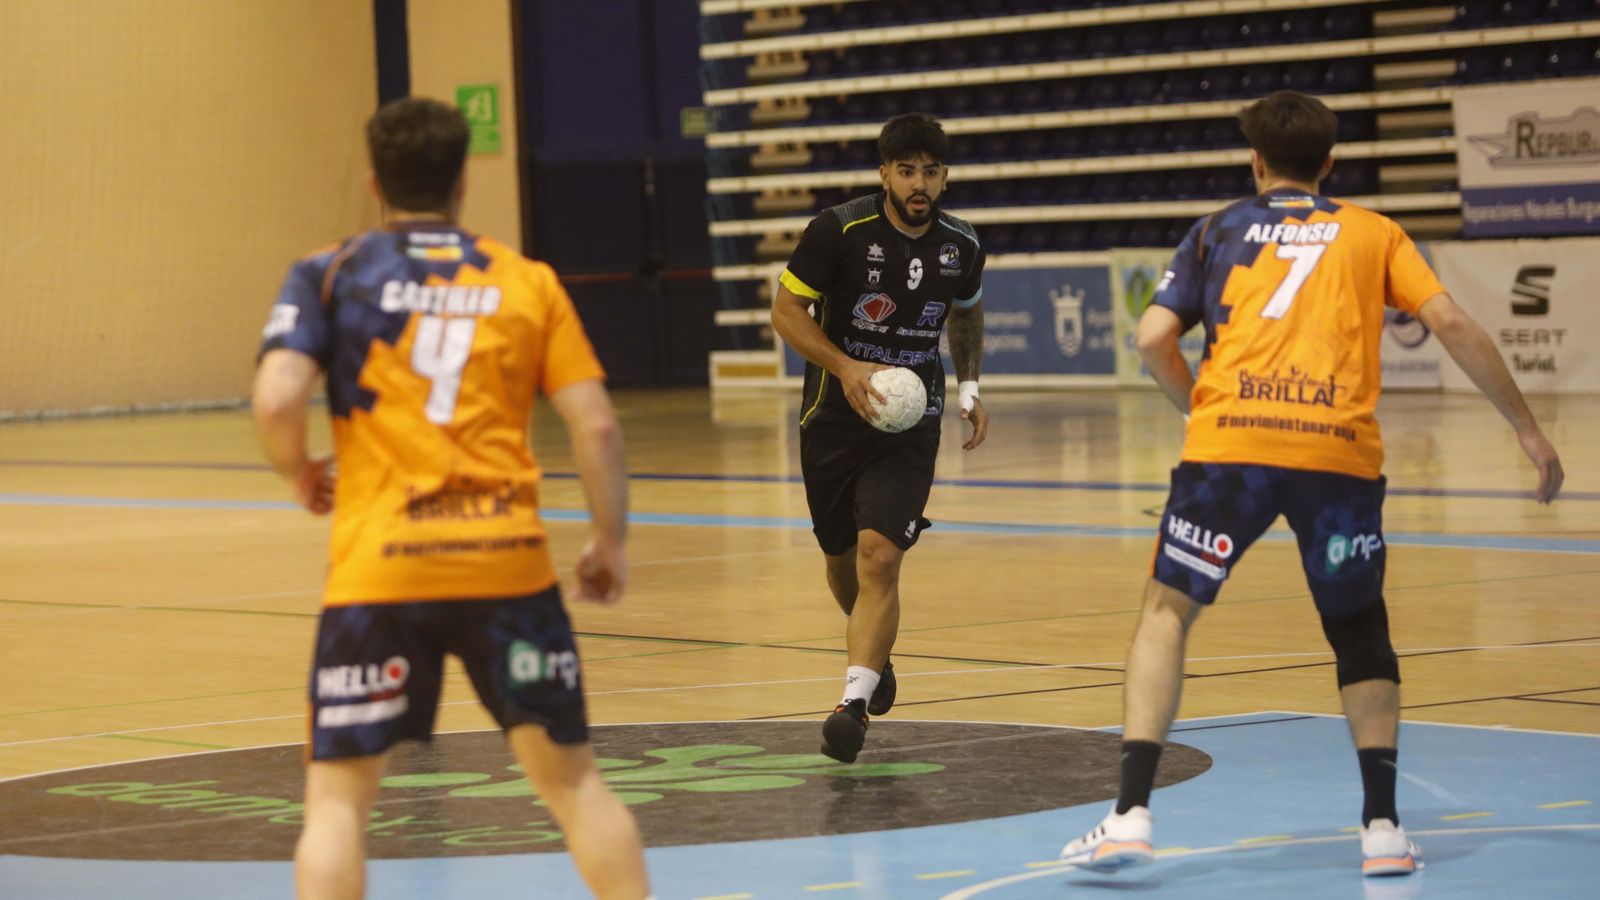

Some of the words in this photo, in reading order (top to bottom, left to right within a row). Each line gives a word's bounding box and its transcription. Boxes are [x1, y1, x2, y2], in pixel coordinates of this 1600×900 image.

[1243, 221, 1341, 245] ALFONSO
[906, 257, 924, 290] 9
[1260, 243, 1328, 320] 7
[411, 314, 477, 426] 4
[844, 336, 939, 366] VITALDENT
[1168, 514, 1234, 559] HELLO
[318, 656, 410, 700] HELLO
